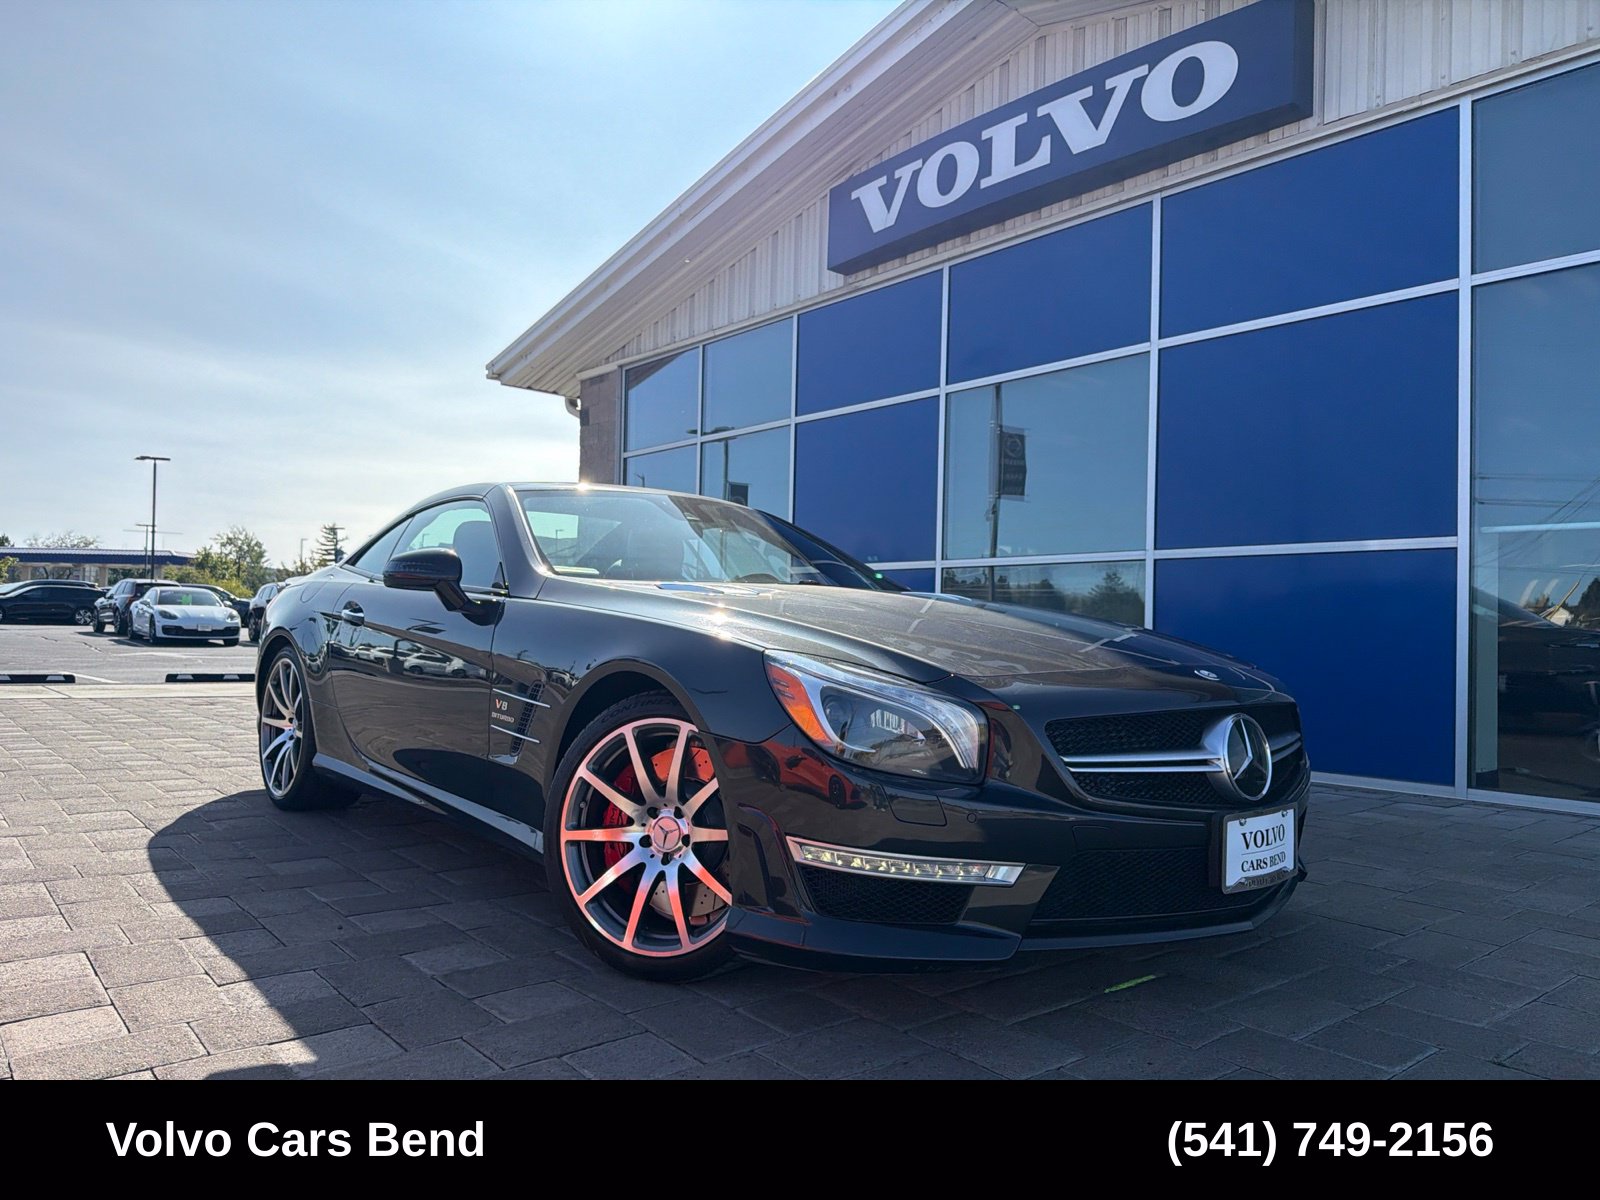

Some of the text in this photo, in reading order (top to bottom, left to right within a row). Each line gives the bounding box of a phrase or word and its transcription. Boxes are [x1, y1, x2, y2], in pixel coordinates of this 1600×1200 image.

[851, 40, 1239, 233] VOLVO
[495, 698, 508, 711] V8
[1241, 823, 1285, 850] VOLVO
[1241, 851, 1286, 873] CARS BEND
